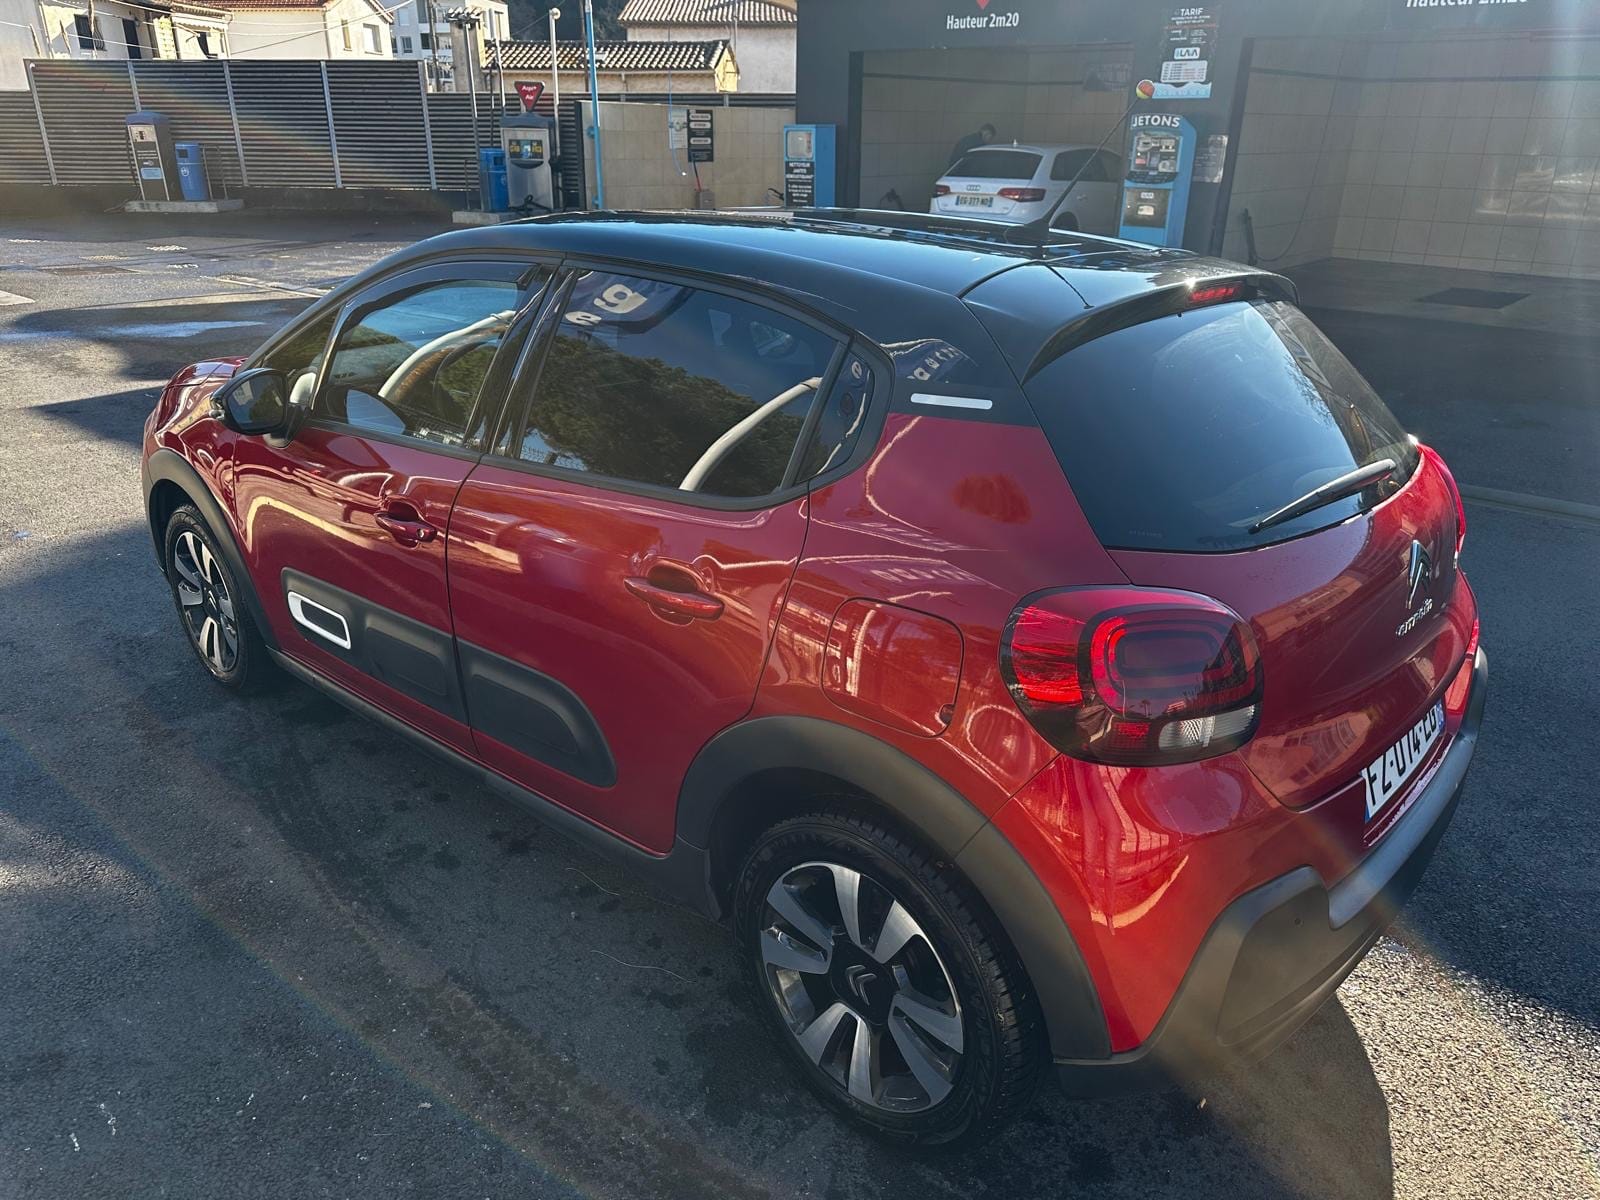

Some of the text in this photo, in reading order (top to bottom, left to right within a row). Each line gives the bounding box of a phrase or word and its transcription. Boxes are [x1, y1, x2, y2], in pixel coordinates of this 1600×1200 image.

[1180, 8, 1204, 16] TARIF
[946, 12, 1020, 29] Hauteur 2m20
[1132, 115, 1180, 127] JETONS
